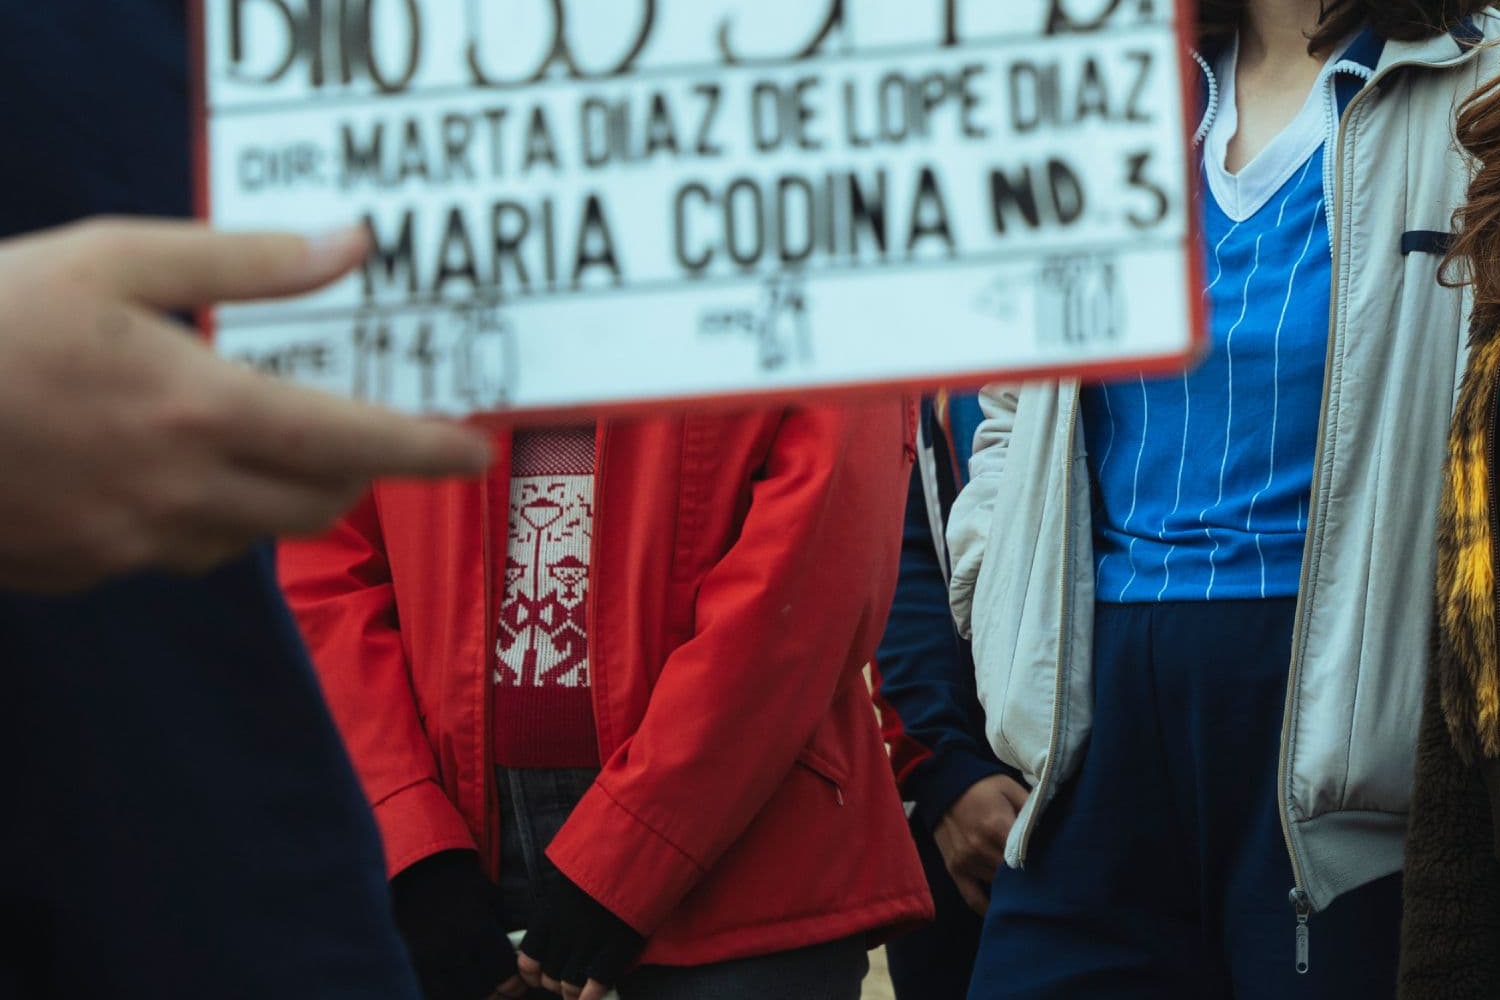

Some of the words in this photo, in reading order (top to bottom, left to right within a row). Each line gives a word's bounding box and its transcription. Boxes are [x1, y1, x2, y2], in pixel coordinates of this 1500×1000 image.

[339, 102, 562, 192] MARTA
[578, 79, 724, 172] DIAZ
[749, 78, 824, 155] DE
[842, 64, 988, 148] LOPE
[1006, 50, 1155, 134] DIAZ
[360, 192, 622, 303] MARIA
[674, 165, 955, 274] CODINA
